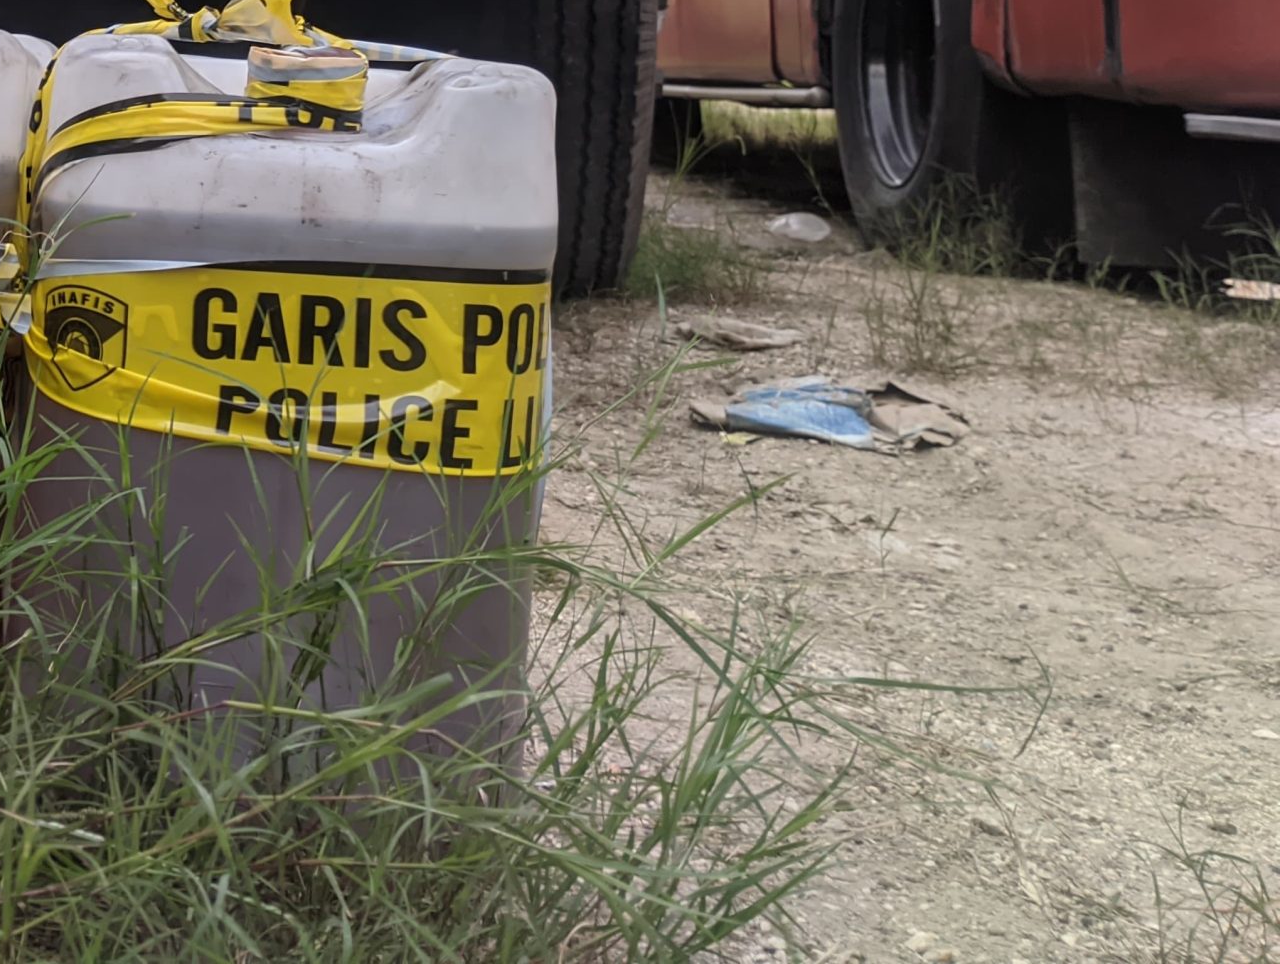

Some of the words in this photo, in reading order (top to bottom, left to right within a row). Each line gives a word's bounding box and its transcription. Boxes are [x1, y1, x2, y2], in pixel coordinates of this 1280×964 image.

[51, 291, 116, 315] INAFIS
[192, 287, 428, 373] GARIS
[215, 384, 478, 470] POLICE
